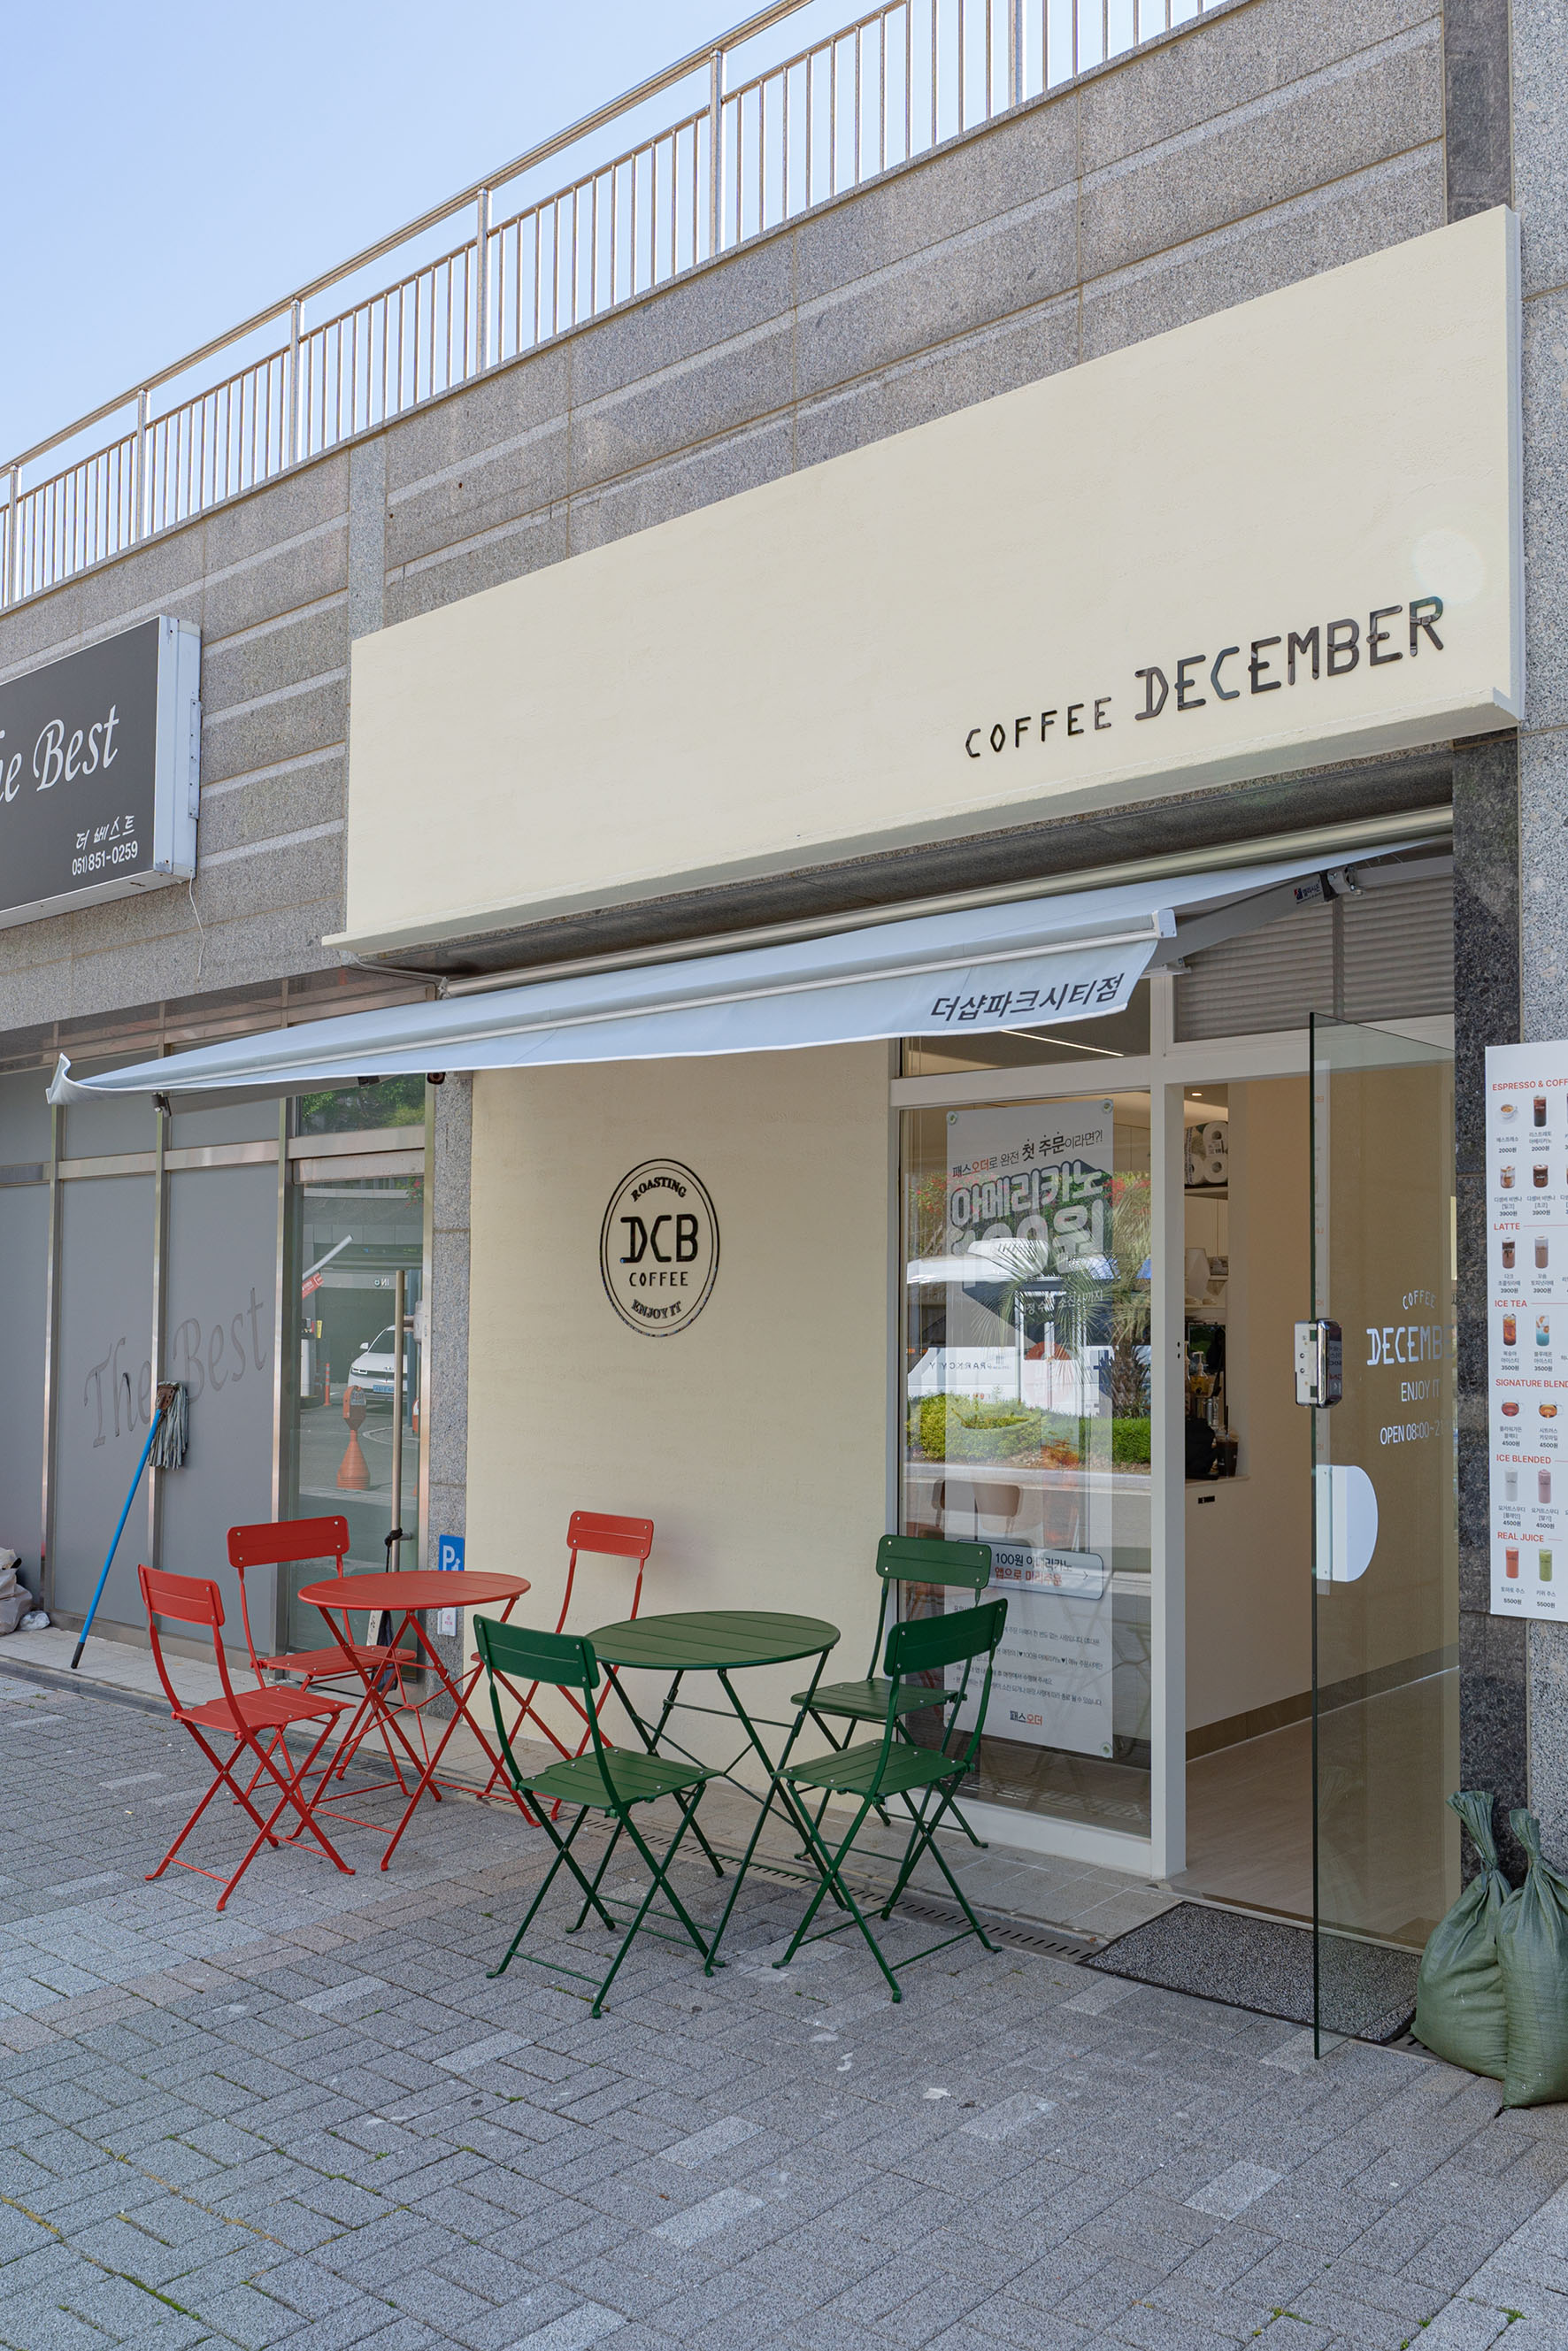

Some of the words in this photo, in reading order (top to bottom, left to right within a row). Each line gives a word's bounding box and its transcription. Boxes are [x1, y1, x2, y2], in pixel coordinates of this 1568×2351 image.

[965, 695, 1111, 758] COFFEE
[1134, 595, 1444, 721] DECEMBER
[33, 703, 119, 793] Best
[76, 829, 90, 850] 더
[72, 841, 138, 876] 051)851-0259
[931, 972, 1125, 1021] 더샵파크시티점
[1492, 1079, 1536, 1091] ESPRESSO
[952, 1157, 997, 1178] 패스오더로
[1000, 1152, 1018, 1167] 완전
[1022, 1141, 1034, 1161] 첫
[631, 1177, 687, 1202] ROASTING
[951, 1160, 1104, 1226] 아메리카노
[620, 1214, 698, 1264] DCB
[629, 1272, 688, 1287] COFFEE
[631, 1299, 669, 1319] ENJOY
[670, 1301, 682, 1317] IT
[1403, 1289, 1437, 1310] COFFEE
[1366, 1325, 1455, 1365] DECEMBE
[84, 1337, 152, 1448] The
[173, 1287, 266, 1404] Best
[1401, 1380, 1430, 1402] ENJOY
[1495, 1379, 1541, 1387] SIGNATURE
[1380, 1425, 1404, 1445] OPEN
[1512, 1455, 1551, 1464] BLENDED
[1497, 1532, 1518, 1540] REAL
[1520, 1533, 1544, 1542] JUICE
[995, 1553, 1024, 1567] 100원
[995, 1567, 1022, 1580] 앱으로
[1010, 1710, 1042, 1725] 패스오더
